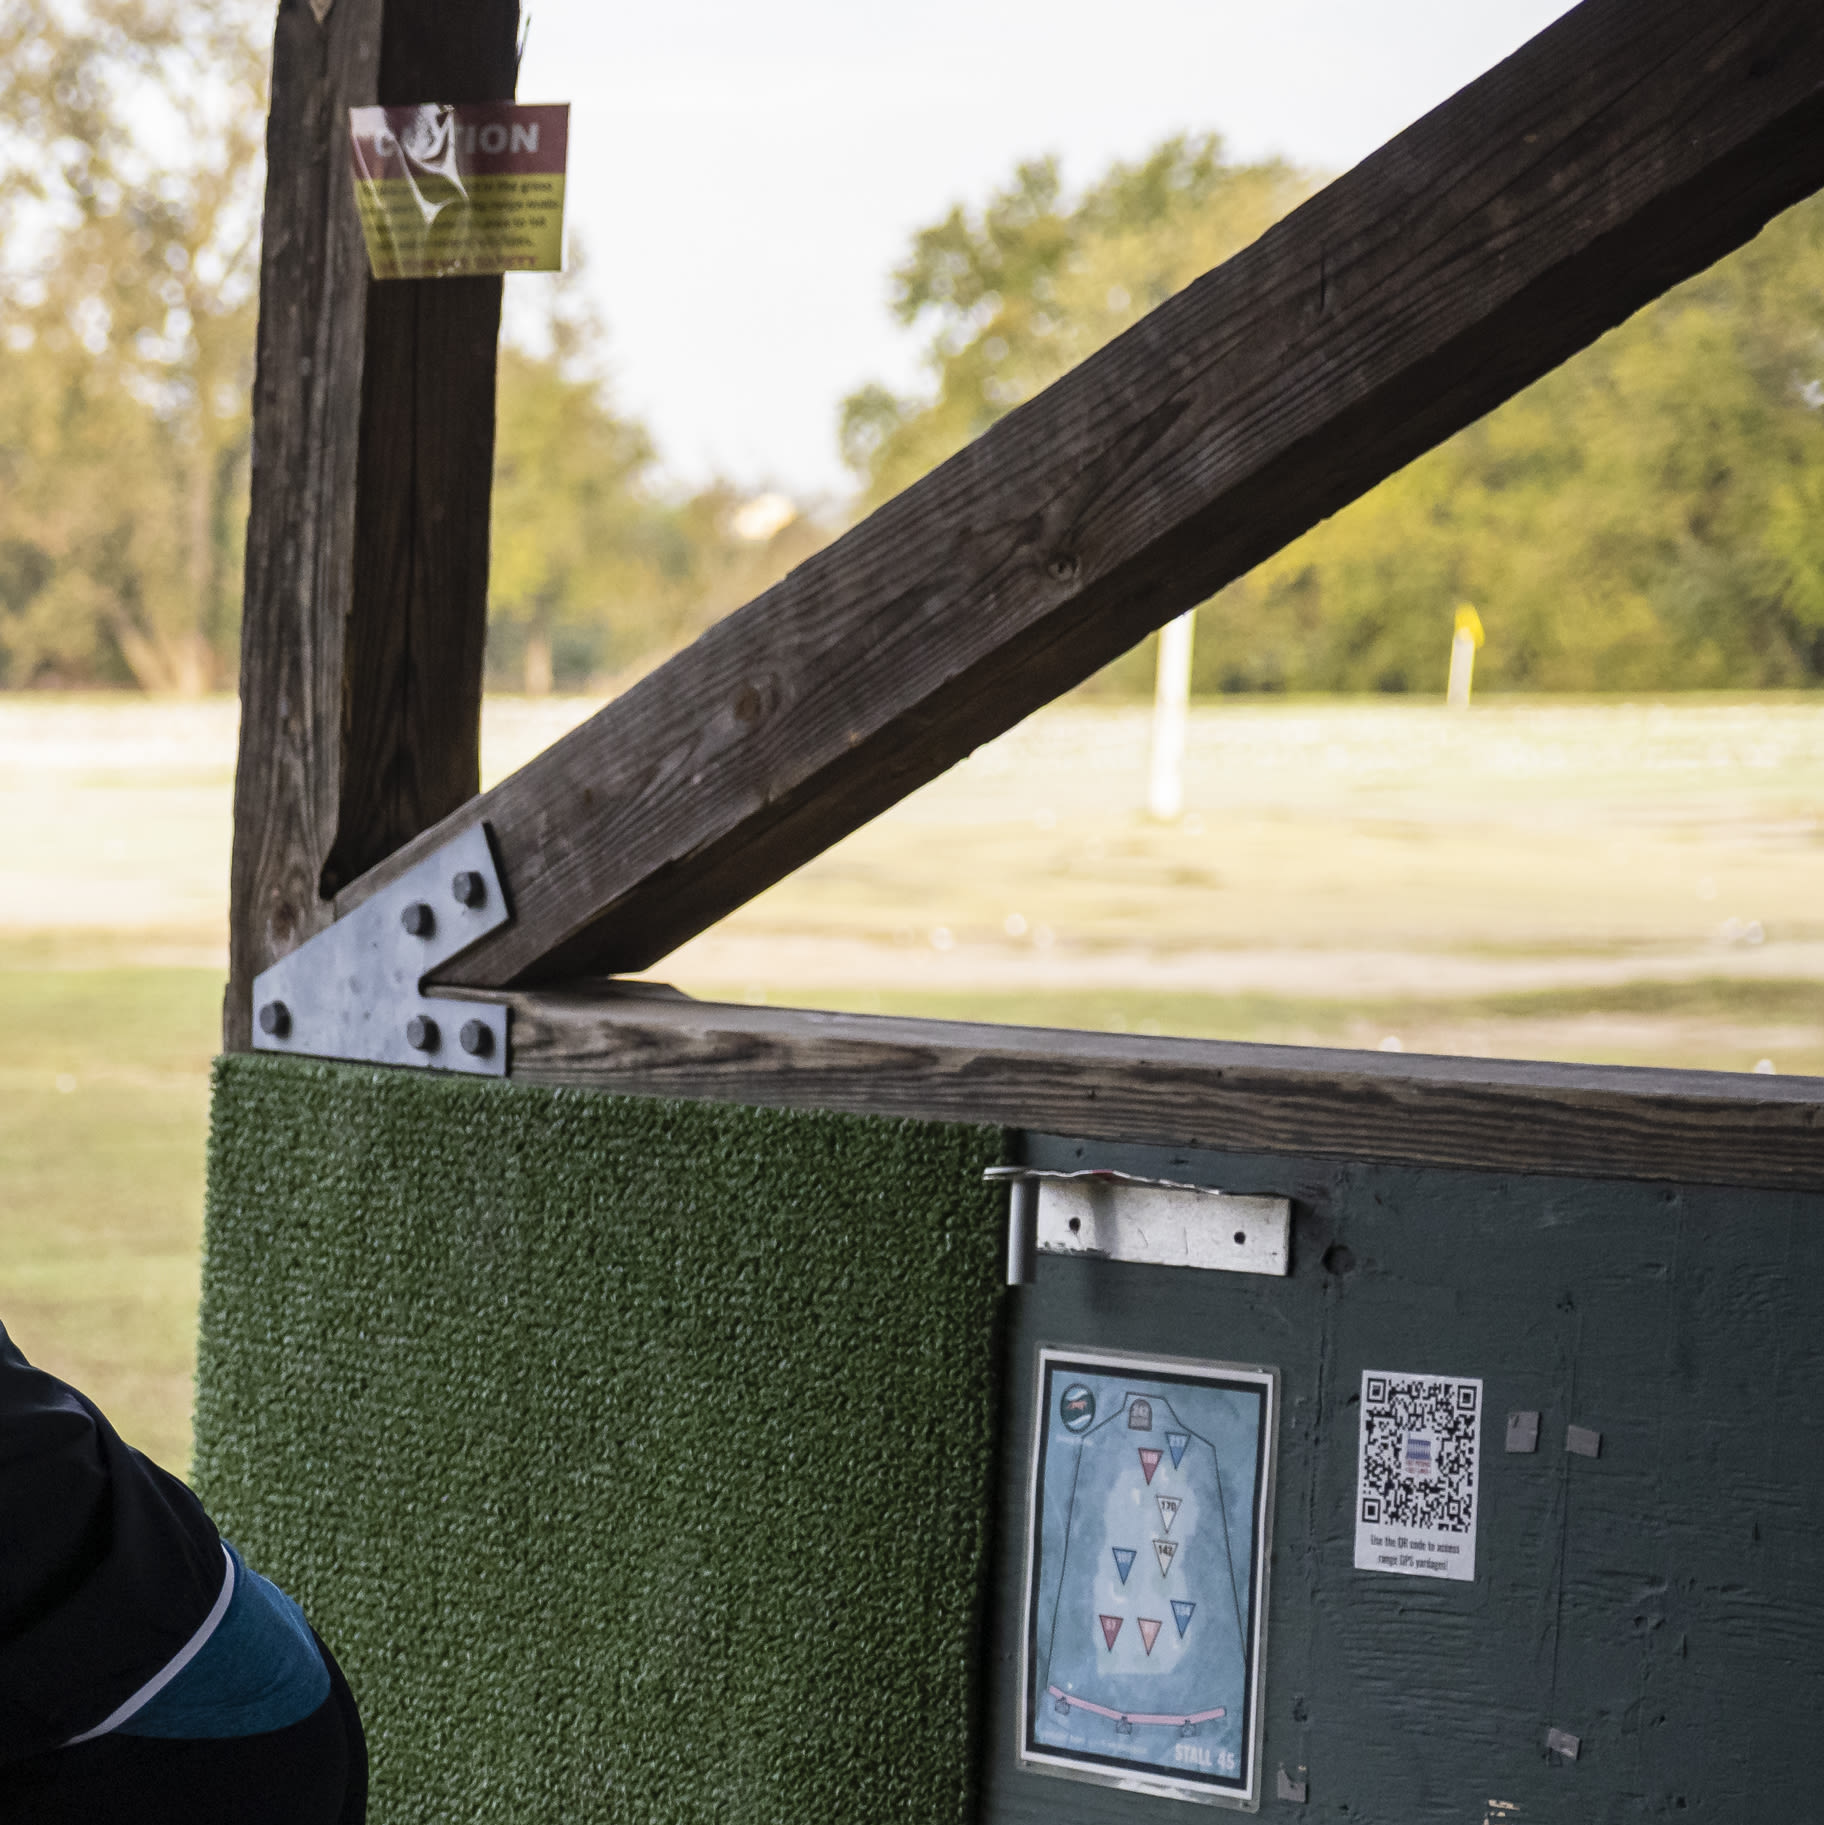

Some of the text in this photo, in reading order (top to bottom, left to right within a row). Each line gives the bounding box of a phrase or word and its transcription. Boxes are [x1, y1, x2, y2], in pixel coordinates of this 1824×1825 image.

[1161, 1501, 1177, 1512] 170
[1370, 1534, 1383, 1546] Use
[1385, 1536, 1396, 1548] the
[1398, 1537, 1409, 1549] QR
[1410, 1539, 1426, 1551] code
[1428, 1541, 1436, 1552] to
[1175, 1743, 1212, 1767] STALL
